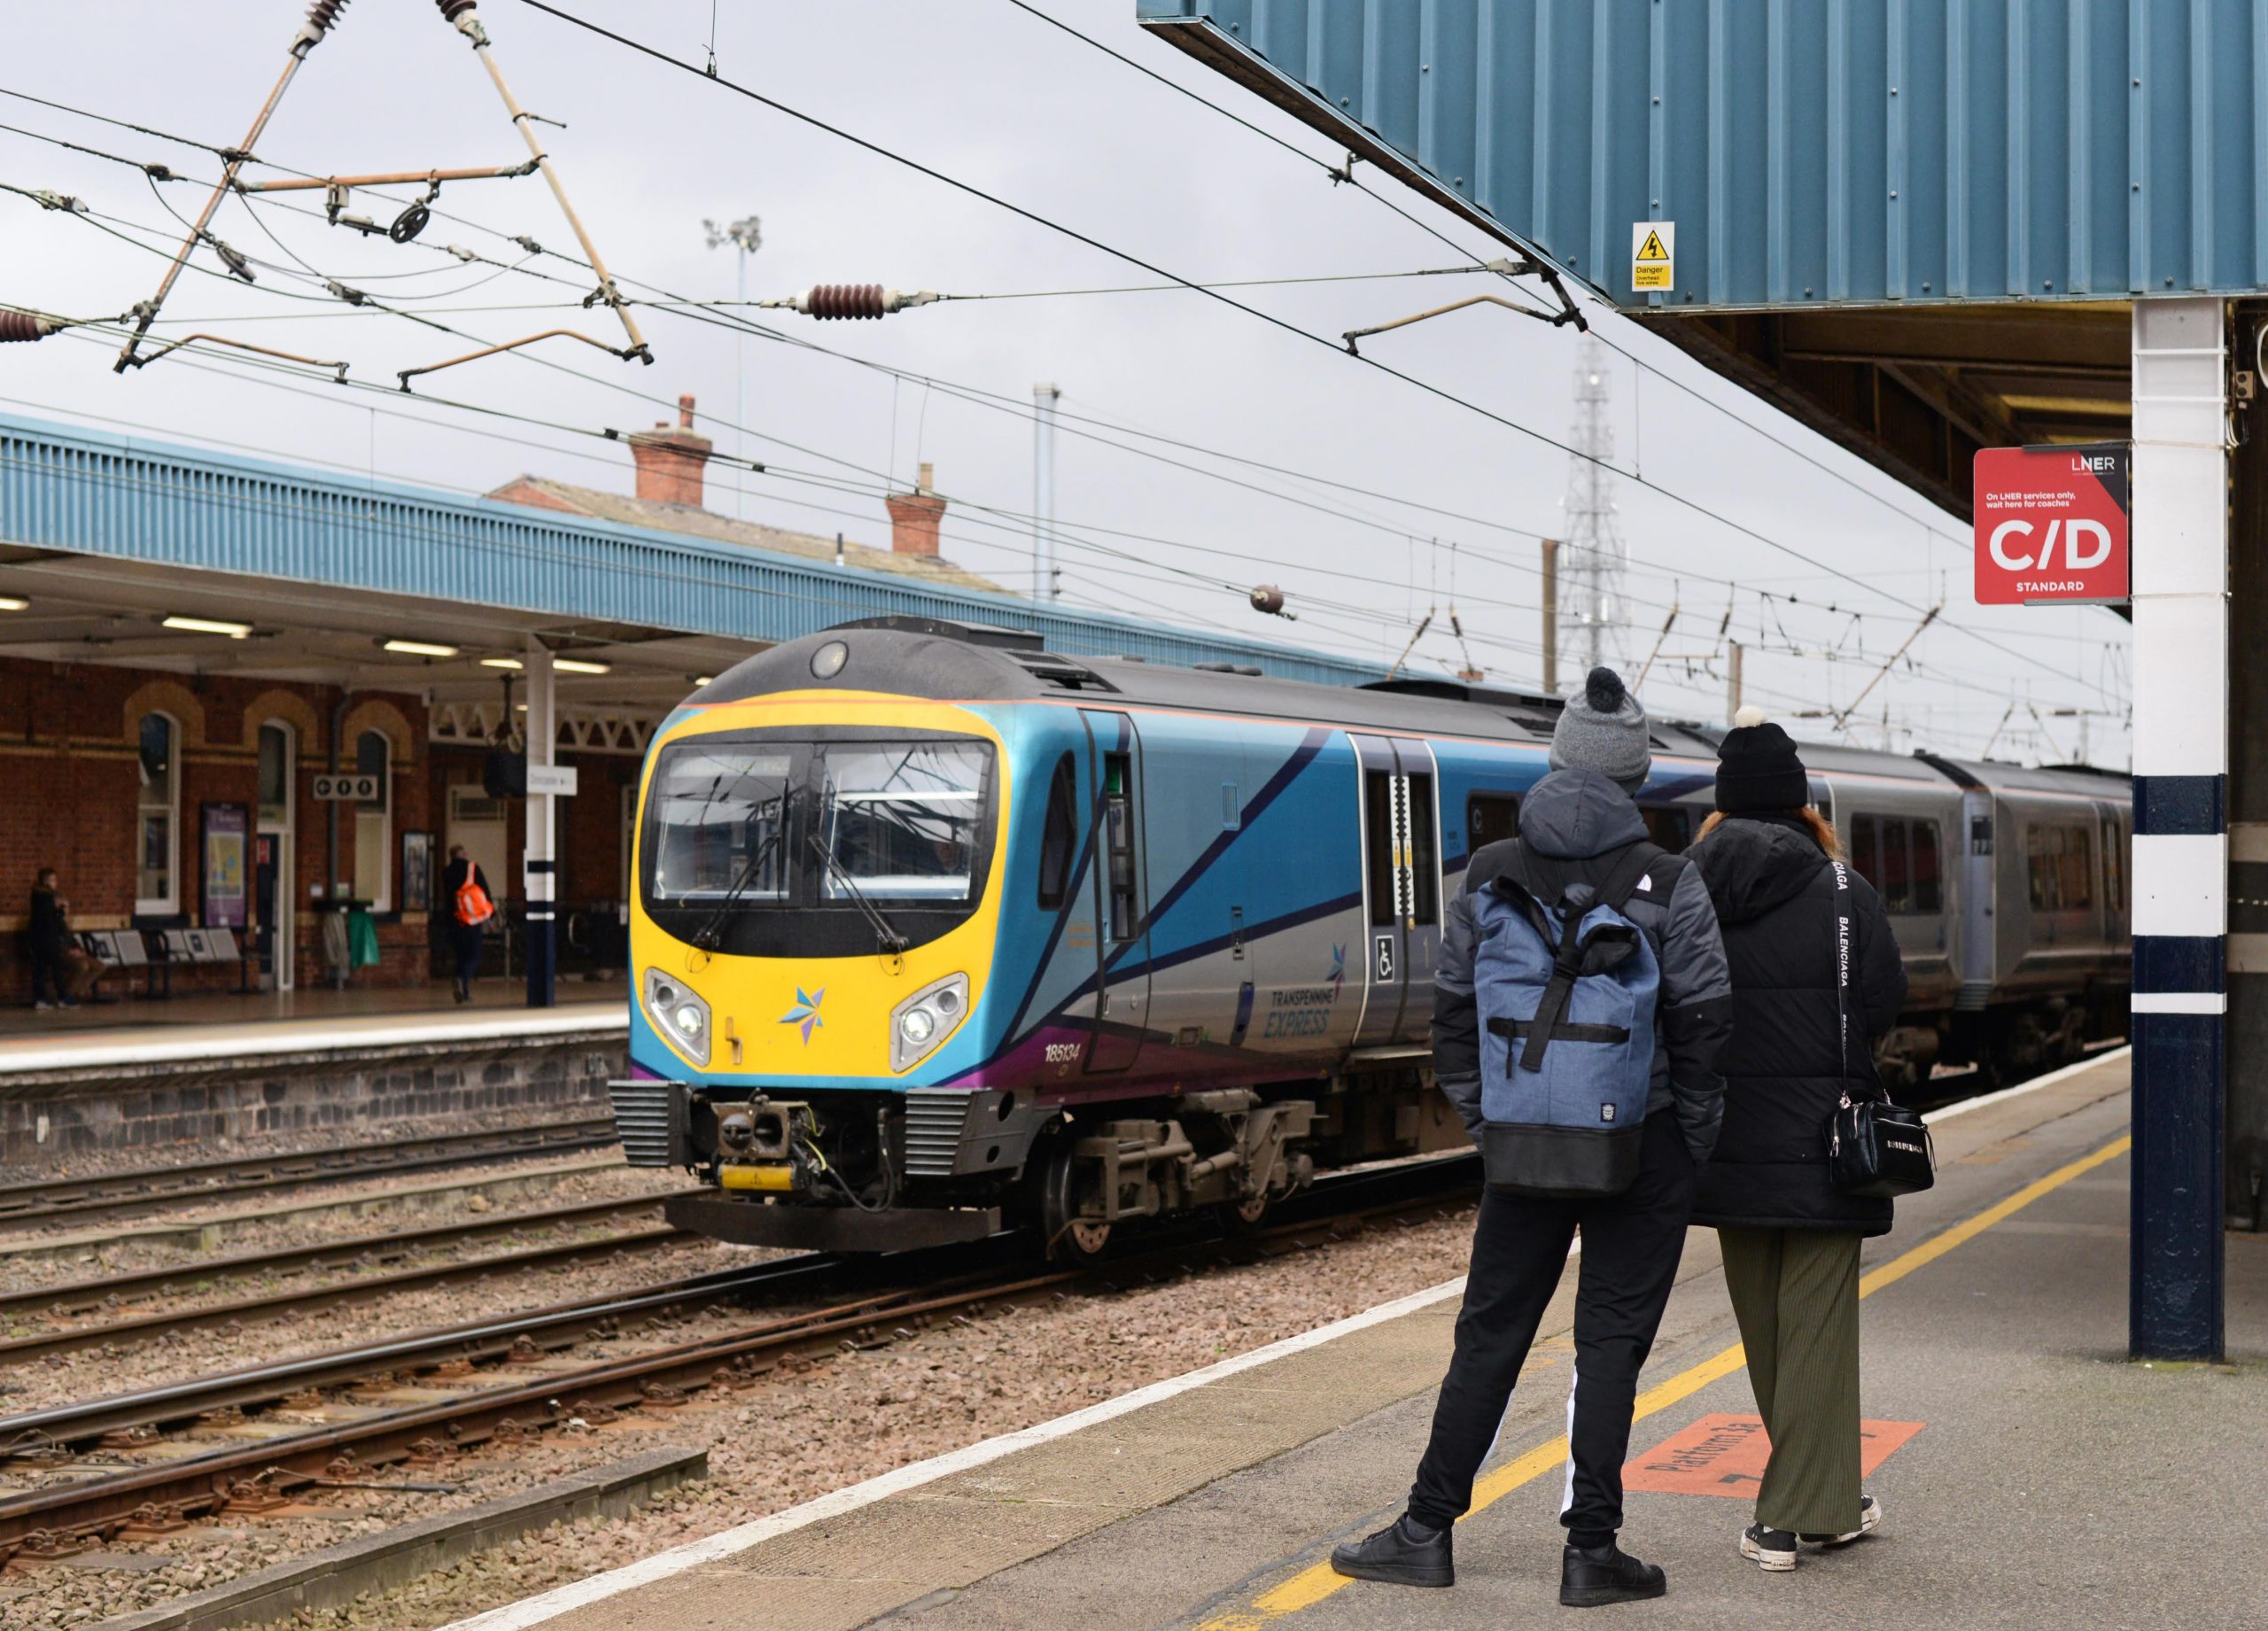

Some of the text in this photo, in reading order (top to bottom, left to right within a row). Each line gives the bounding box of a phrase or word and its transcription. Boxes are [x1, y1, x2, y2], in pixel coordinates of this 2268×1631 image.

[2071, 455, 2115, 471] LNER
[2056, 491, 2076, 500] only,
[1989, 518, 2112, 571] C/D
[2016, 581, 2085, 592] STANDARD
[1830, 861, 1848, 890] CIAGA
[1838, 916, 1849, 987] BALENCIAGA
[1272, 988, 1334, 1007] TRANSPENNINE
[1263, 1008, 1331, 1038] EXPRESS
[1045, 1043, 1081, 1062] 185134
[1643, 1433, 1748, 1472] Platform
